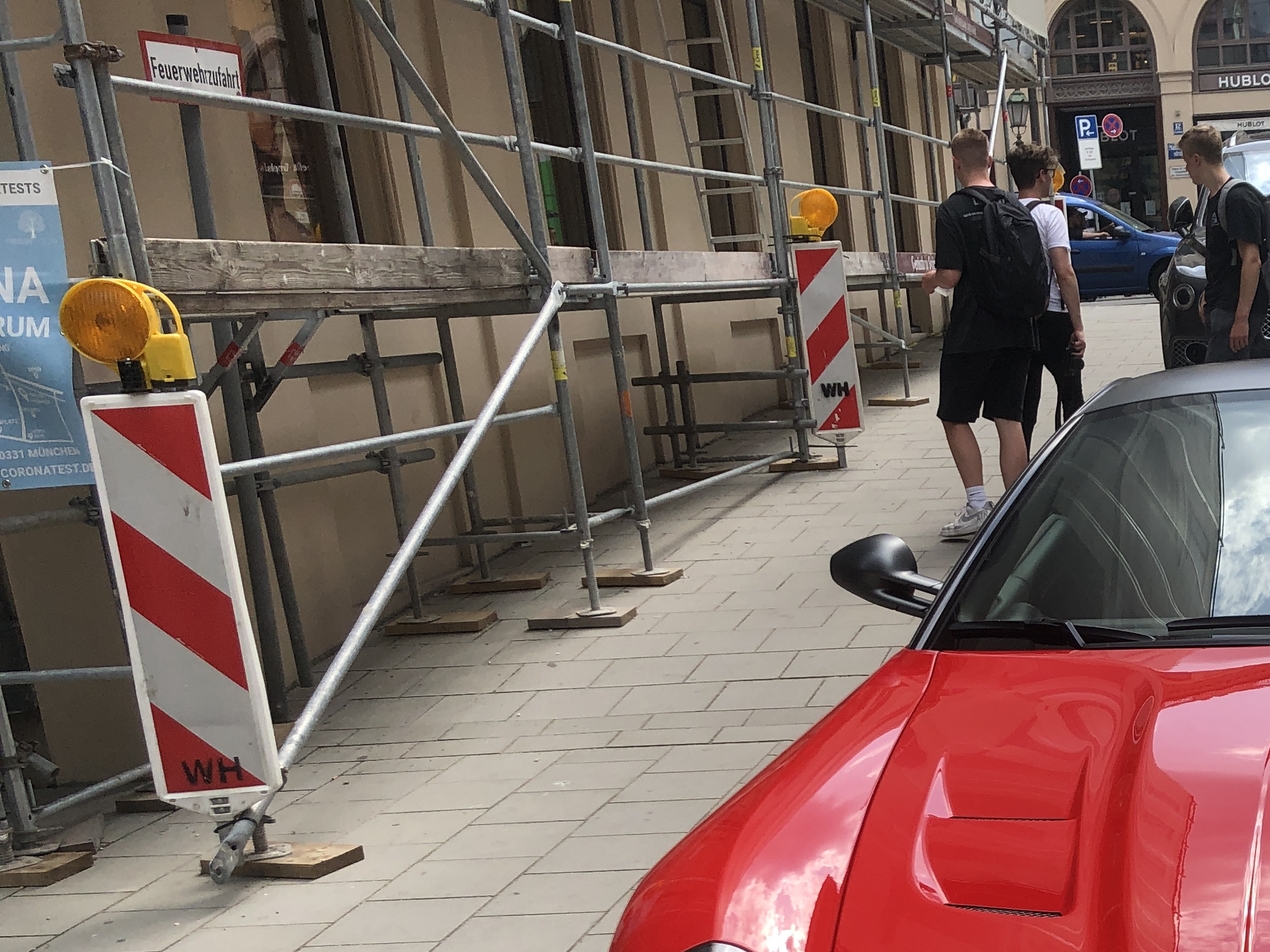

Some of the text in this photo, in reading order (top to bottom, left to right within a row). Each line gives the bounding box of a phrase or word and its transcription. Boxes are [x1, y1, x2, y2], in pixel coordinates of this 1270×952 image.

[150, 56, 240, 90] Feuerwehrzufahrt
[0, 182, 41, 194] TESTS
[821, 381, 850, 398] WH
[28, 446, 80, 458] MÜNCHEN
[182, 756, 243, 784] WH
